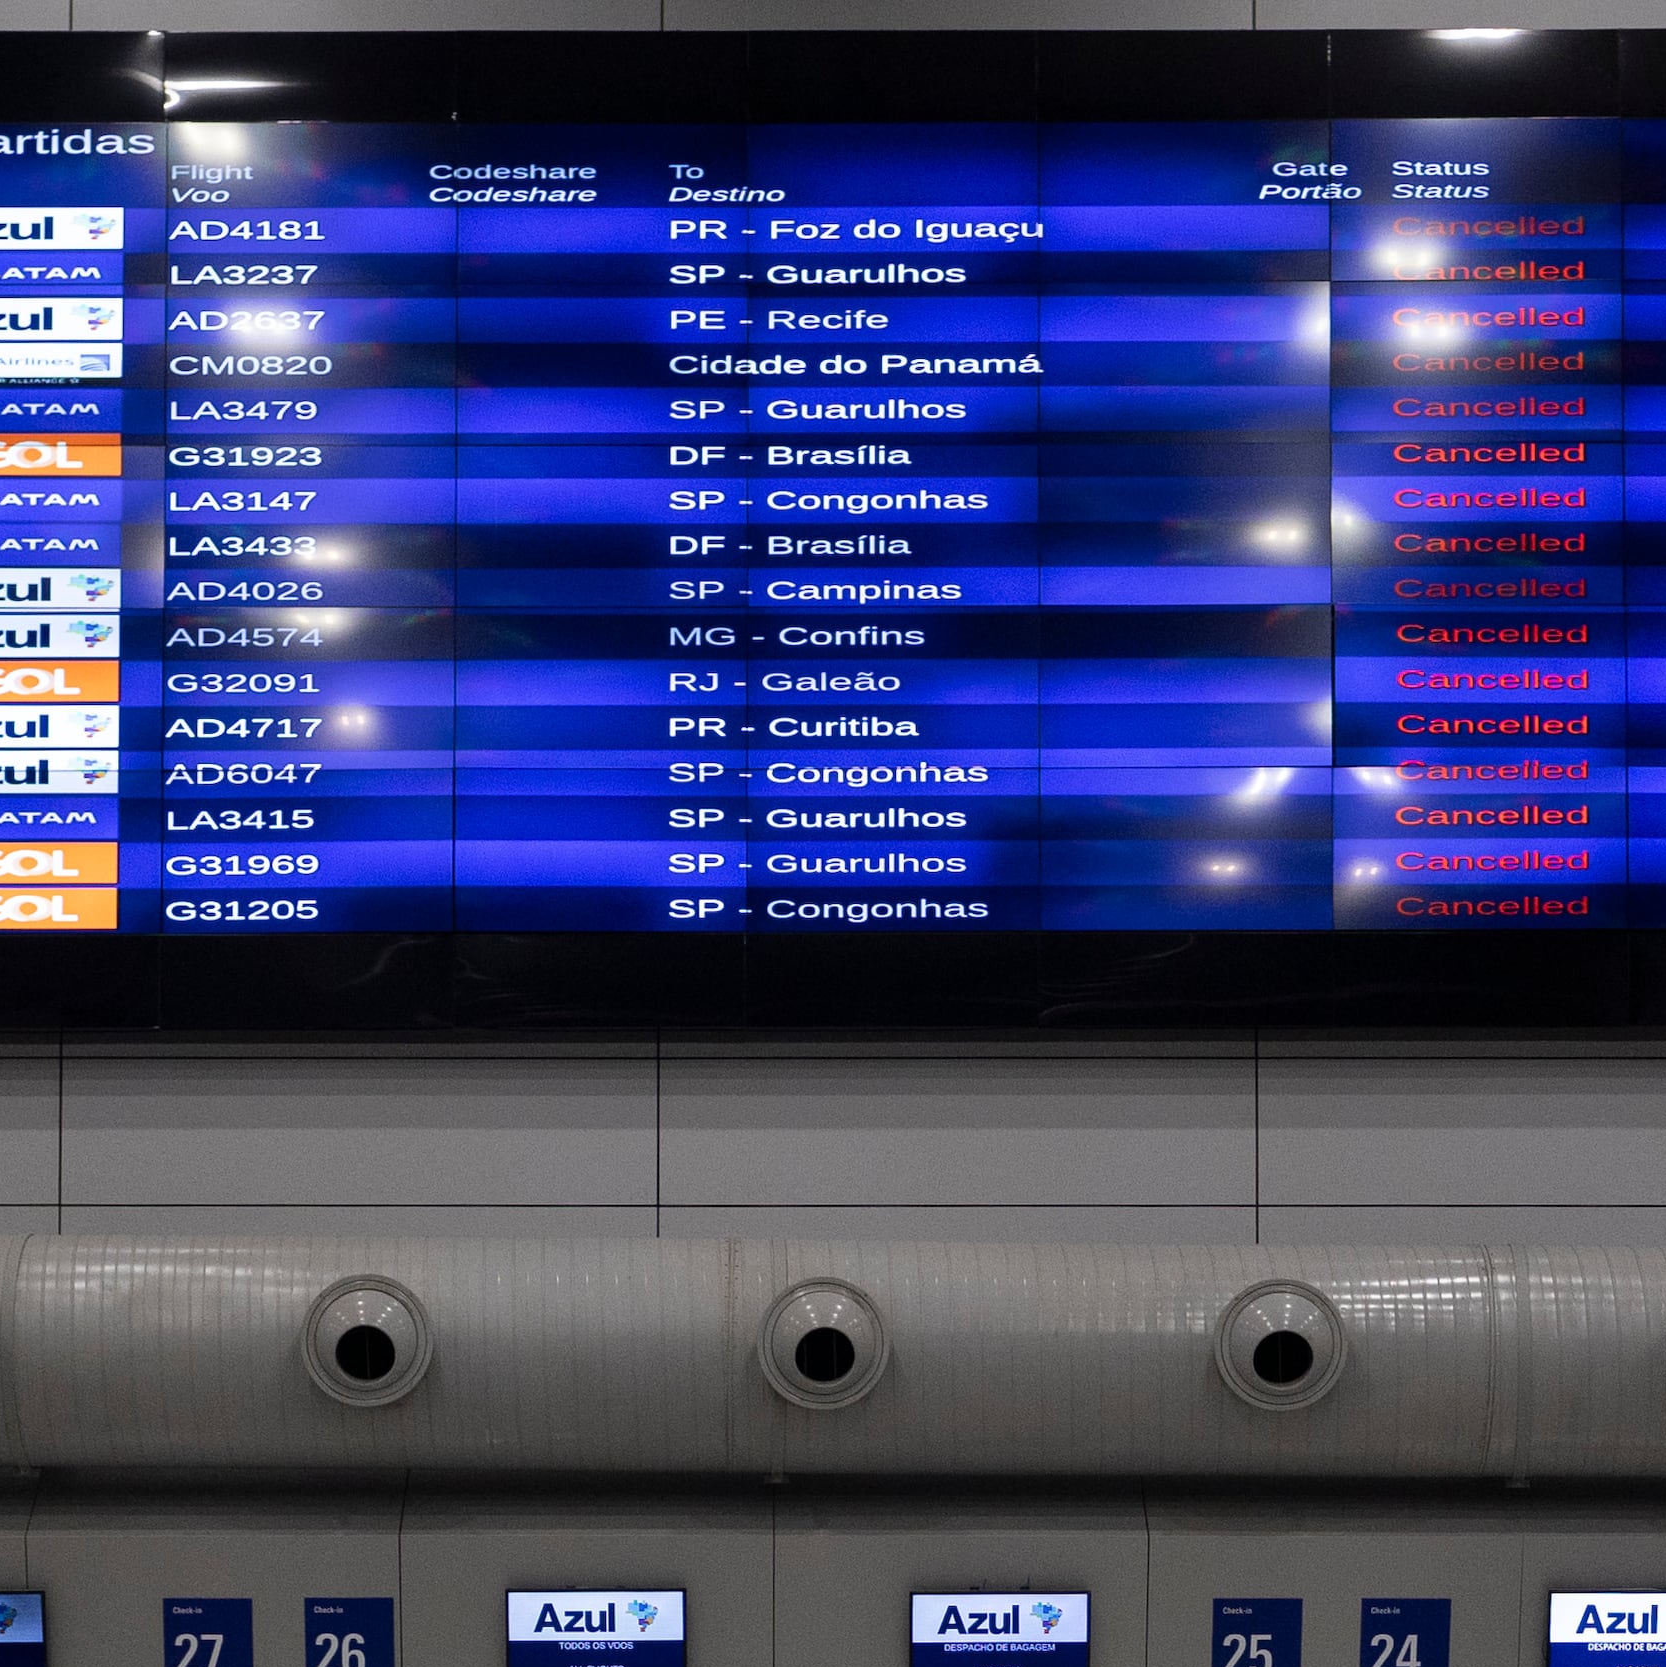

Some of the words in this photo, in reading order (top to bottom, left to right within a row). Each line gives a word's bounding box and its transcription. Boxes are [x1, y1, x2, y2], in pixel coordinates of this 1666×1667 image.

[170, 164, 254, 181] Flight
[429, 164, 597, 180] Codeshare
[668, 164, 704, 180] To
[1272, 161, 1348, 177] Gate
[1392, 160, 1490, 176] Status
[172, 187, 230, 203] Voo
[429, 186, 597, 203] Codeshare
[668, 186, 786, 203] Destino
[1258, 182, 1362, 200] Portão
[1391, 183, 1489, 199] Status
[169, 220, 325, 241] AD4181
[670, 219, 727, 240] PR
[770, 220, 841, 240] Foz
[853, 218, 901, 240] do
[915, 218, 1044, 244] Iguaçu
[1391, 216, 1585, 237] Cancelled
[169, 350, 332, 376] CM0820
[669, 354, 807, 375] Cidade
[819, 354, 868, 375] do
[881, 353, 1044, 375] Panamá
[168, 446, 322, 467] G31923
[669, 445, 726, 466] DF
[767, 444, 912, 466] Brasília
[1393, 443, 1586, 464] Cancelled
[167, 673, 321, 693] G32091
[669, 672, 719, 692] RJ
[761, 671, 901, 692] Galeão
[1396, 670, 1590, 691] Cancelled
[165, 718, 323, 739] AD4717
[669, 717, 726, 738] PR
[768, 716, 920, 738] Curitiba
[1395, 715, 1590, 736] Cancelled
[167, 809, 315, 831] LA3415
[668, 808, 725, 829] SP
[766, 807, 967, 829] Guarulhos
[1395, 806, 1590, 827] Cancelled
[533, 1602, 616, 1633] Azul
[937, 1604, 1020, 1635] Azul
[559, 1641, 590, 1650] TODOS
[943, 1643, 994, 1652] DESPACHO
[995, 1643, 1009, 1652] DE
[1010, 1643, 1056, 1652] BAGAGEM
